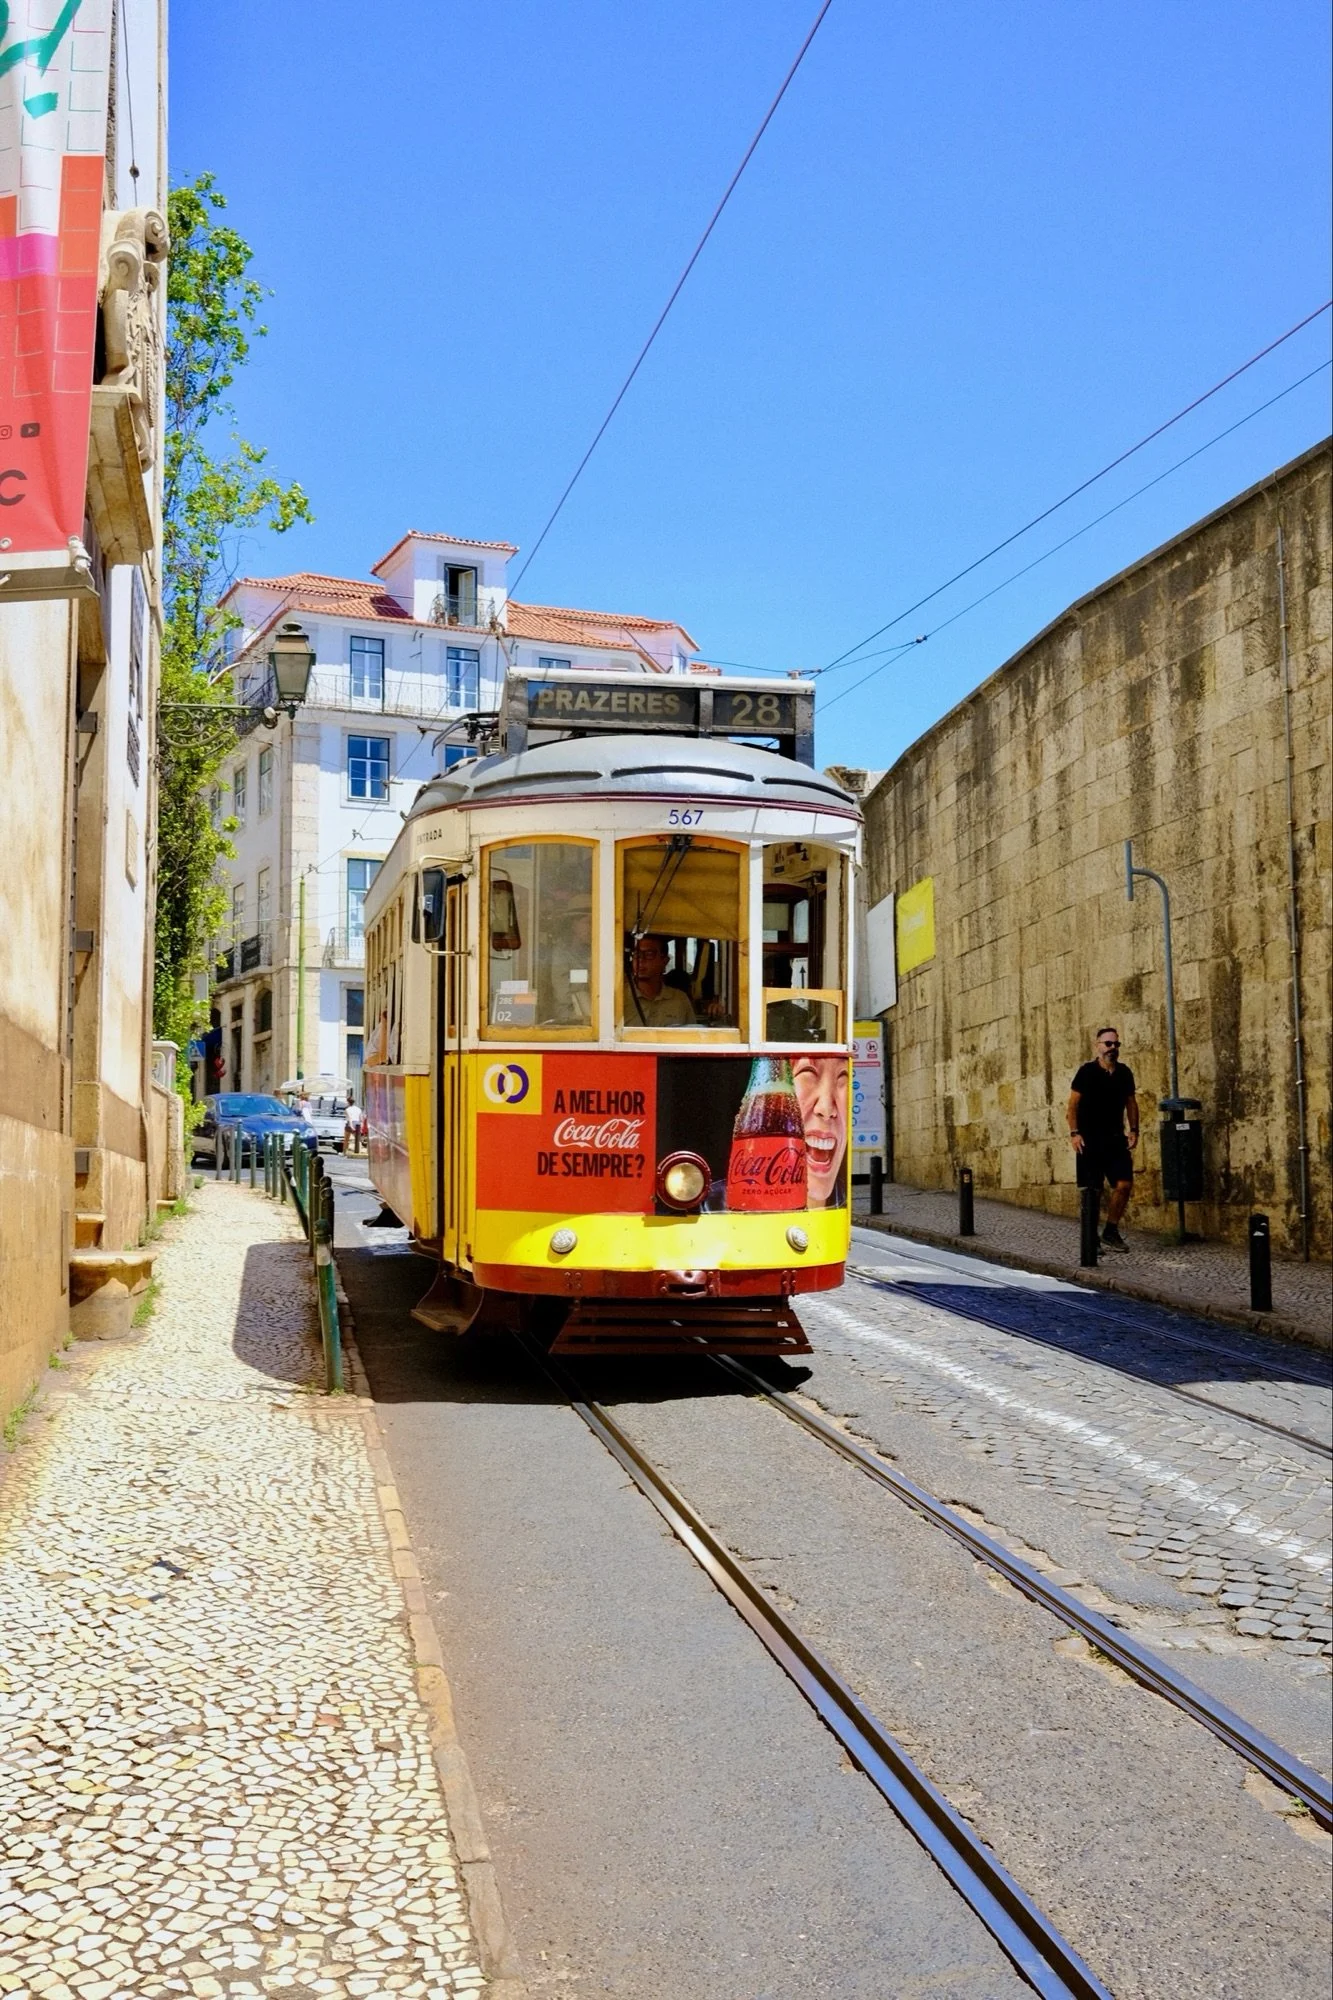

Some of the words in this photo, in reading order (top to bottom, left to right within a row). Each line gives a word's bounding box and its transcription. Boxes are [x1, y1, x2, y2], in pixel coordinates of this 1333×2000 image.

[537, 688, 681, 716] PRAZERES
[731, 693, 781, 726] 28
[669, 809, 704, 825] 567
[497, 1011, 512, 1022] 02
[553, 1089, 566, 1114] A
[569, 1090, 645, 1115] MELHOR
[553, 1117, 646, 1149] Coca-Cola
[537, 1151, 559, 1176] DE
[561, 1152, 645, 1178] SEMPRE?
